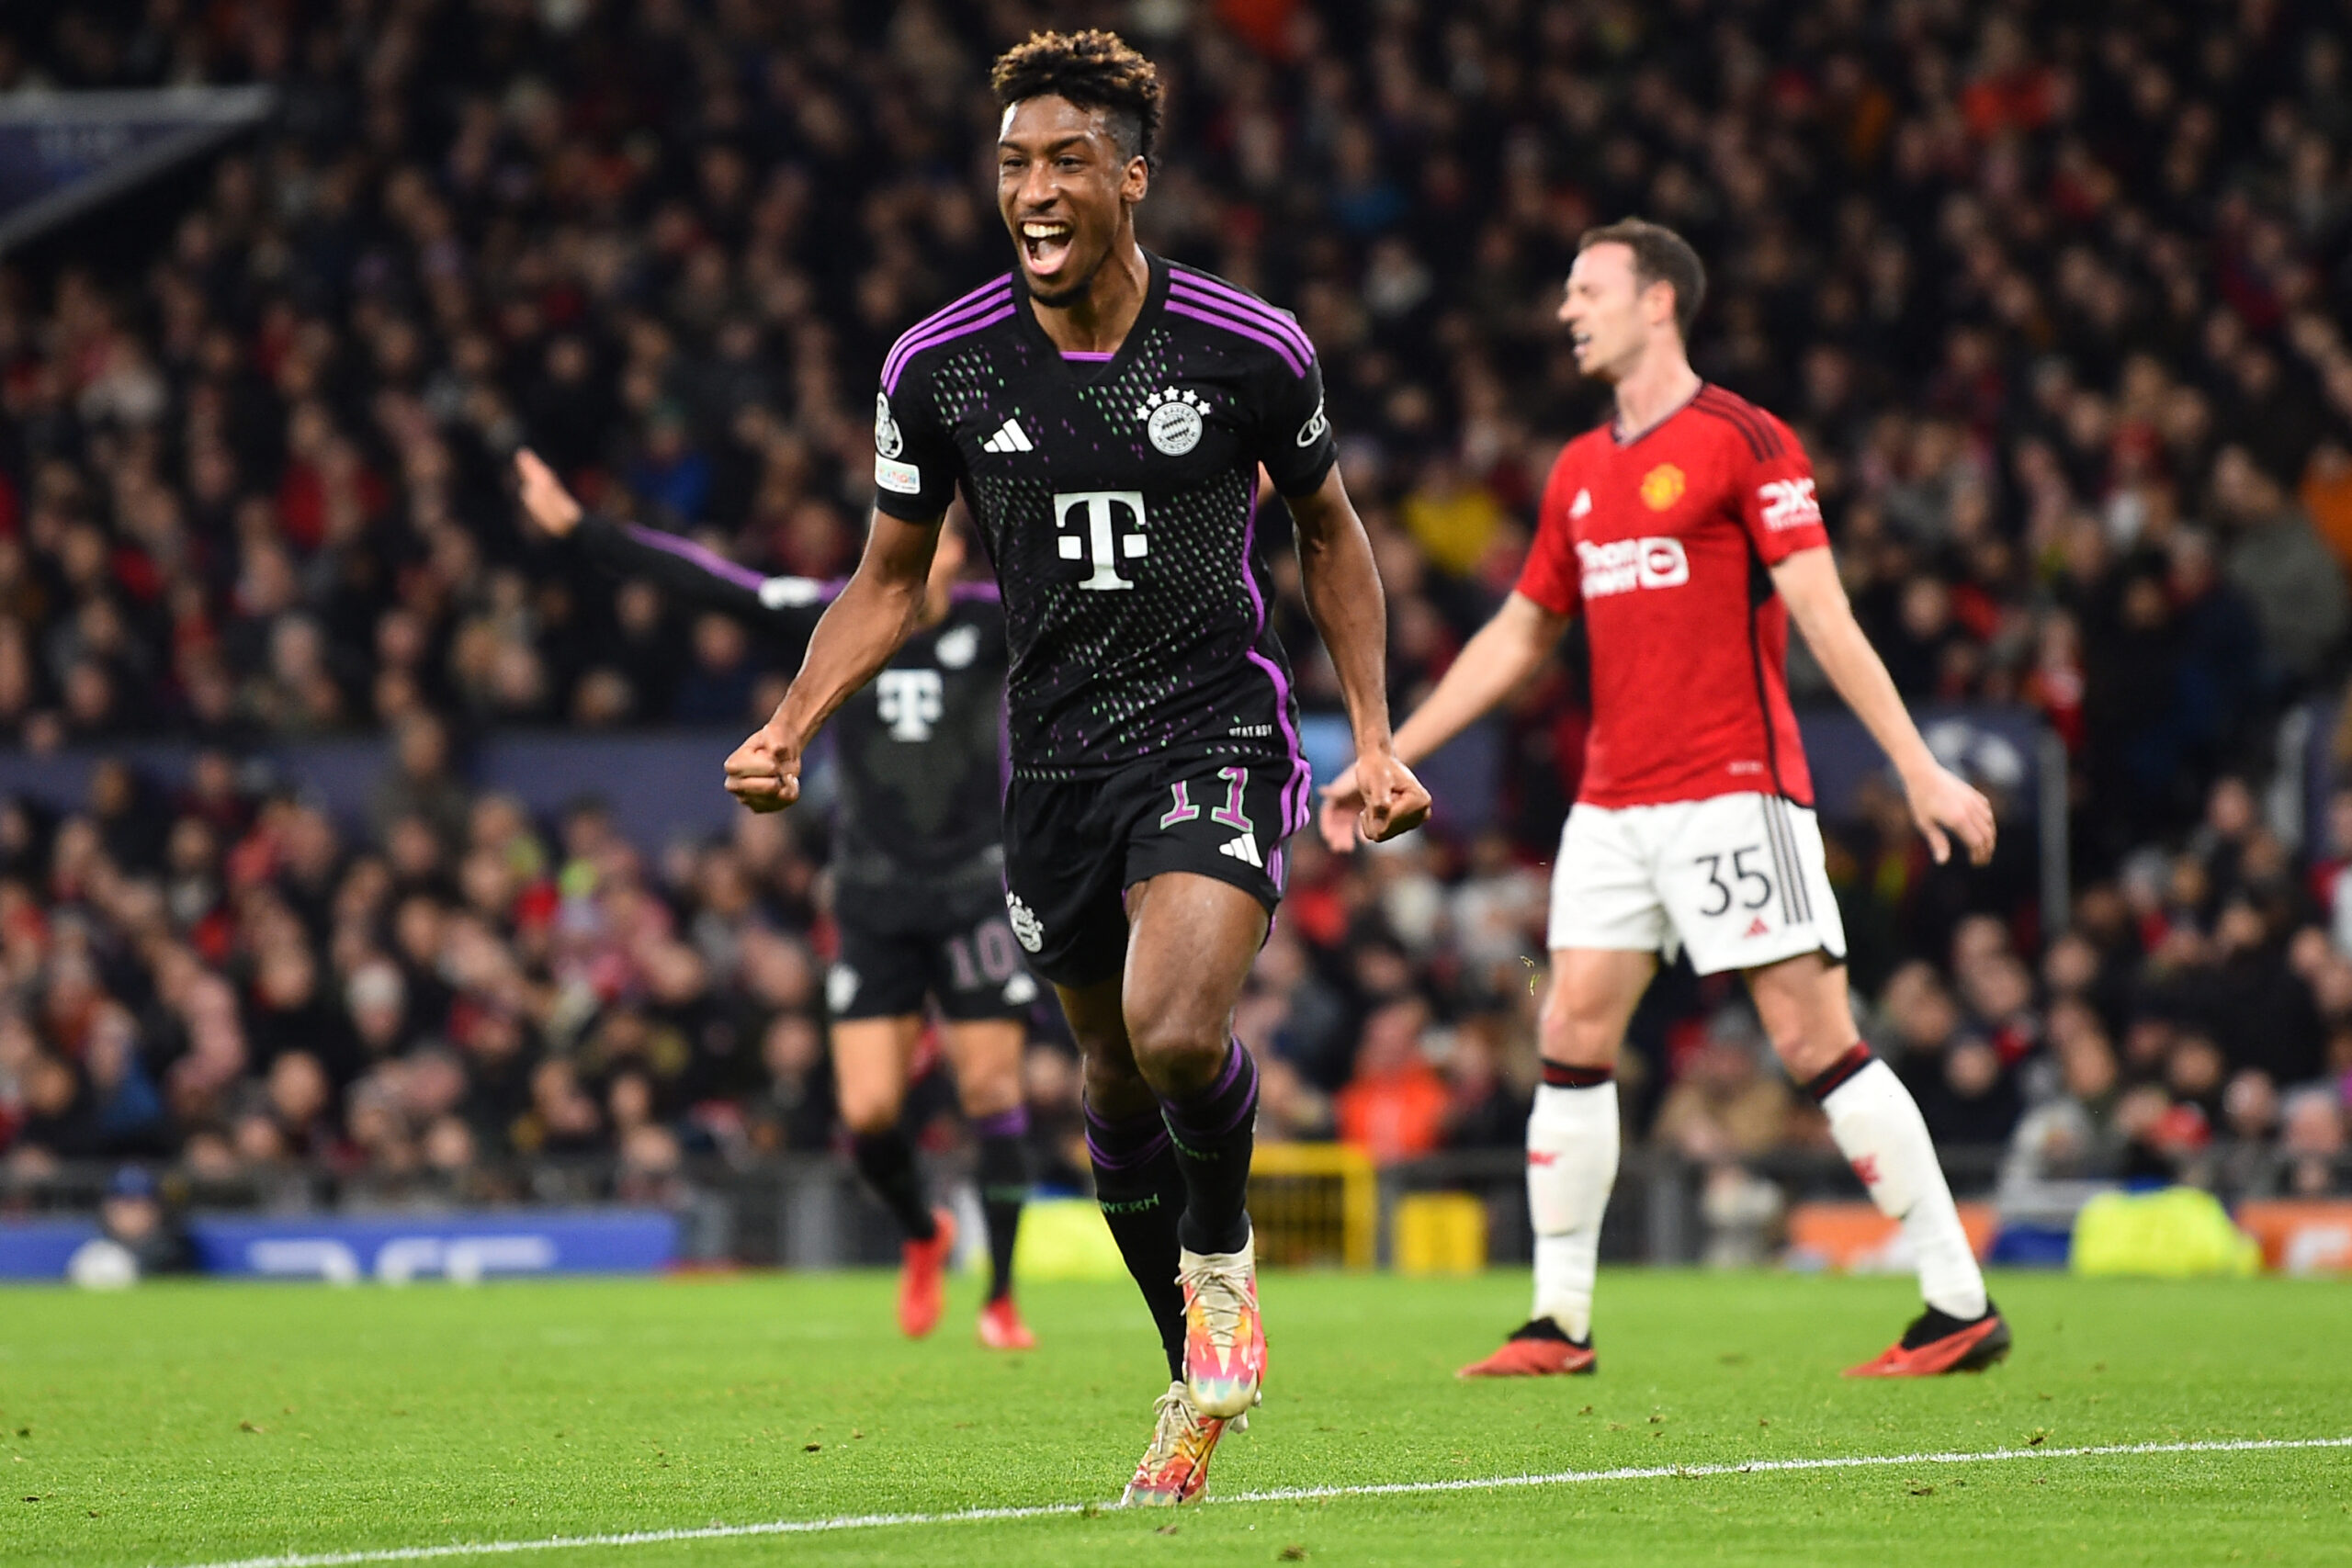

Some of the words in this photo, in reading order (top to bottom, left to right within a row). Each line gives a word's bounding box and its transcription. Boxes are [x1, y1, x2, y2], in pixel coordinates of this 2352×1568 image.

[1053, 491, 1148, 591] T
[1159, 766, 1254, 833] 11
[1694, 845, 1772, 917] 35
[945, 919, 1014, 988] 10
